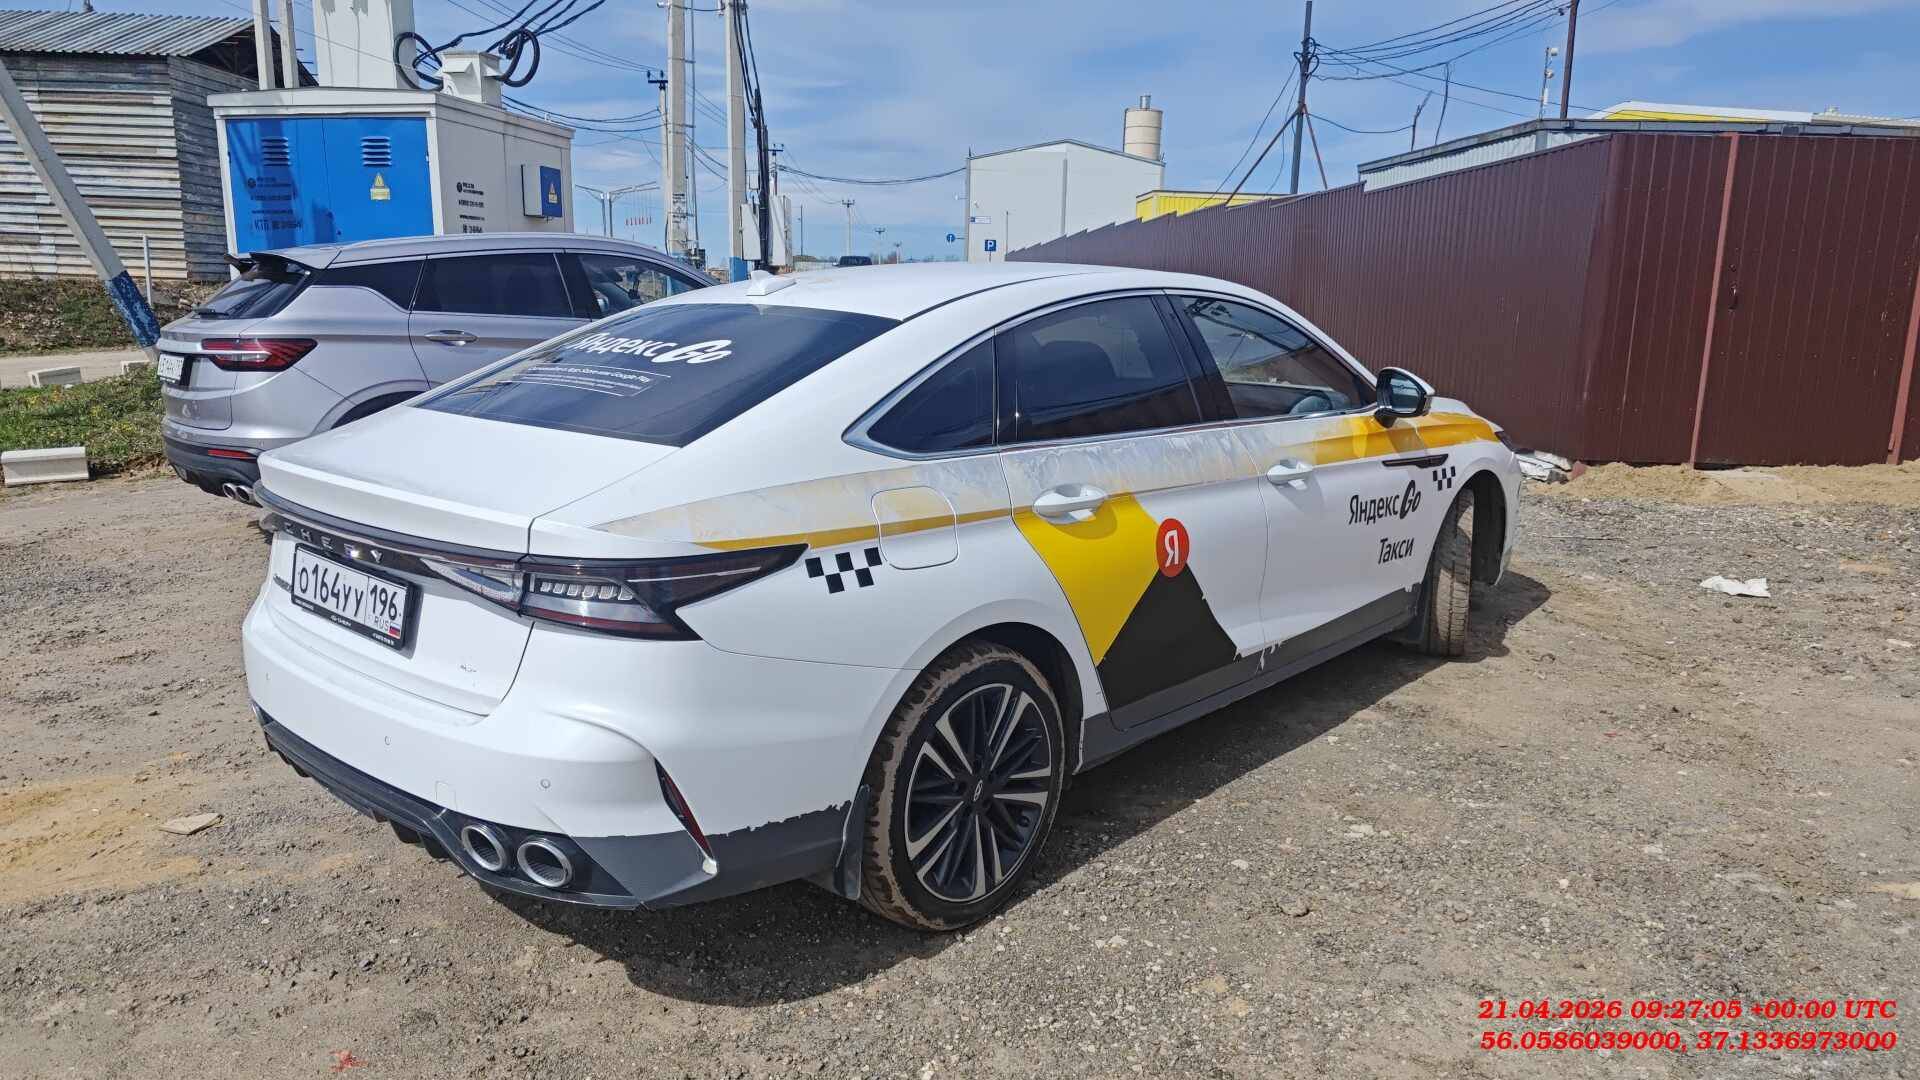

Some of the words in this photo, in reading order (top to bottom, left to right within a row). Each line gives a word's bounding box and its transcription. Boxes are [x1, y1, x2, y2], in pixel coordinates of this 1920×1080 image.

[1164, 529, 1179, 567] Я
[1378, 537, 1415, 565] Такси
[370, 584, 398, 620] 196
[374, 616, 390, 631] RUS
